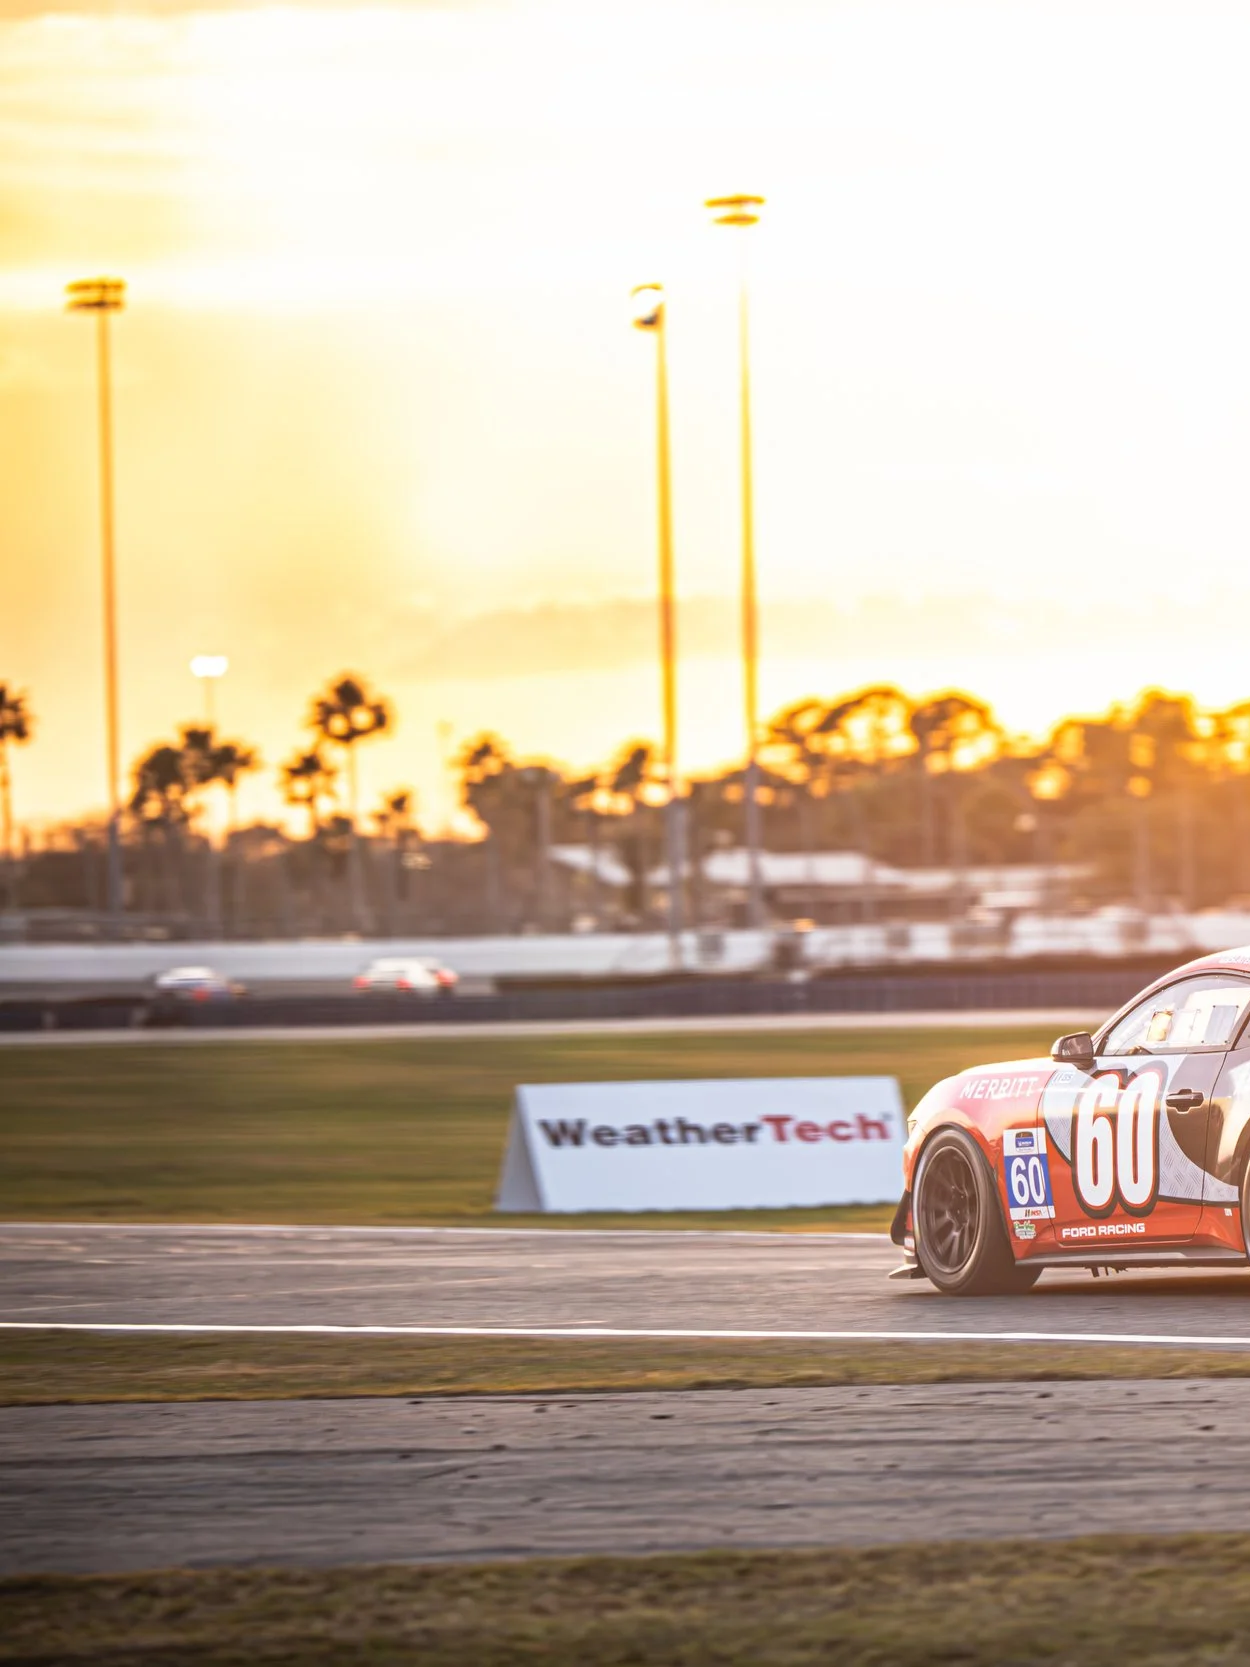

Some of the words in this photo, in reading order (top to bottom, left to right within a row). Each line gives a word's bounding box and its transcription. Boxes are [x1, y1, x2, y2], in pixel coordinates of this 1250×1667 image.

[960, 1078, 1039, 1099] MERRITT
[1076, 1071, 1161, 1208] 60
[1011, 1156, 1045, 1206] 60
[1062, 1226, 1097, 1238] FORD
[1098, 1223, 1146, 1236] RACING
